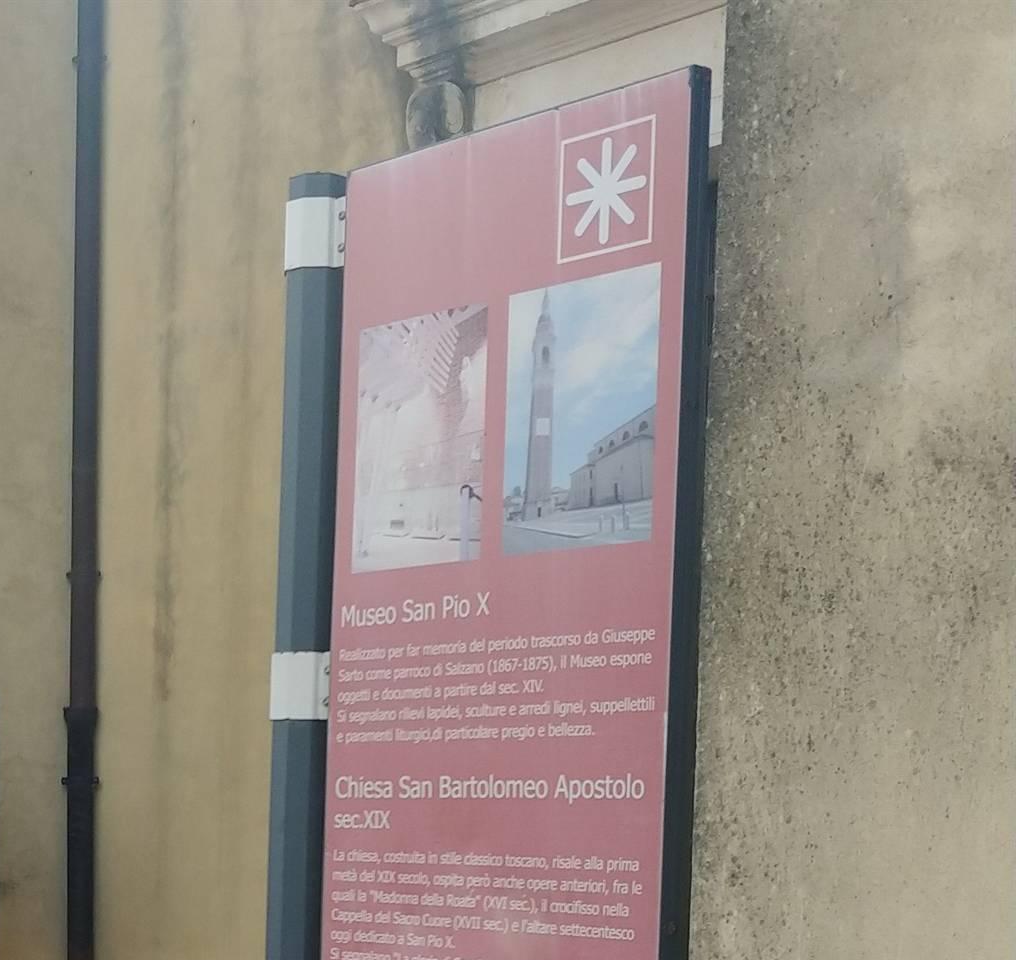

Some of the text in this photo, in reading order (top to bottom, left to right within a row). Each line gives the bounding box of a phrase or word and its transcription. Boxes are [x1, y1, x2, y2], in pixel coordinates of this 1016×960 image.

[341, 591, 490, 628] Museo San Pio X
[388, 629, 656, 661] per far memoria del periodo trascorso da Giuseppe
[366, 669, 391, 681] come
[434, 663, 442, 676] di
[445, 662, 484, 676] Salzano
[488, 656, 557, 676] (1867-1875),
[560, 655, 567, 668] il
[570, 654, 606, 668] Museo
[610, 653, 652, 668] espone
[372, 691, 380, 700] e
[434, 688, 441, 698] a
[444, 684, 476, 700] partire
[480, 683, 496, 696] dal
[498, 684, 519, 695] sec.
[522, 680, 544, 693] XIV.
[465, 704, 506, 717] sculture
[509, 706, 516, 716] e
[519, 701, 550, 716] arredi
[553, 700, 586, 717] lignei,
[590, 697, 655, 716] suppellettili
[336, 723, 596, 742] e particolare pregio e bellezza.
[335, 773, 645, 804] Chiesa San Bartolomeo Apostolo
[333, 850, 344, 861] La
[428, 852, 438, 864] in
[505, 854, 548, 870] toscano,
[552, 855, 582, 869] risale
[584, 856, 603, 870] alla
[606, 857, 640, 874] prima
[492, 875, 524, 889] anche
[526, 879, 558, 892] opere
[560, 877, 608, 895] anteriori,
[612, 879, 628, 894] fra
[632, 880, 642, 894] le
[541, 899, 548, 912] il
[550, 900, 599, 915] crocifisso
[602, 902, 630, 917] nella
[512, 922, 518, 932] e
[560, 923, 634, 940] settecentesco
